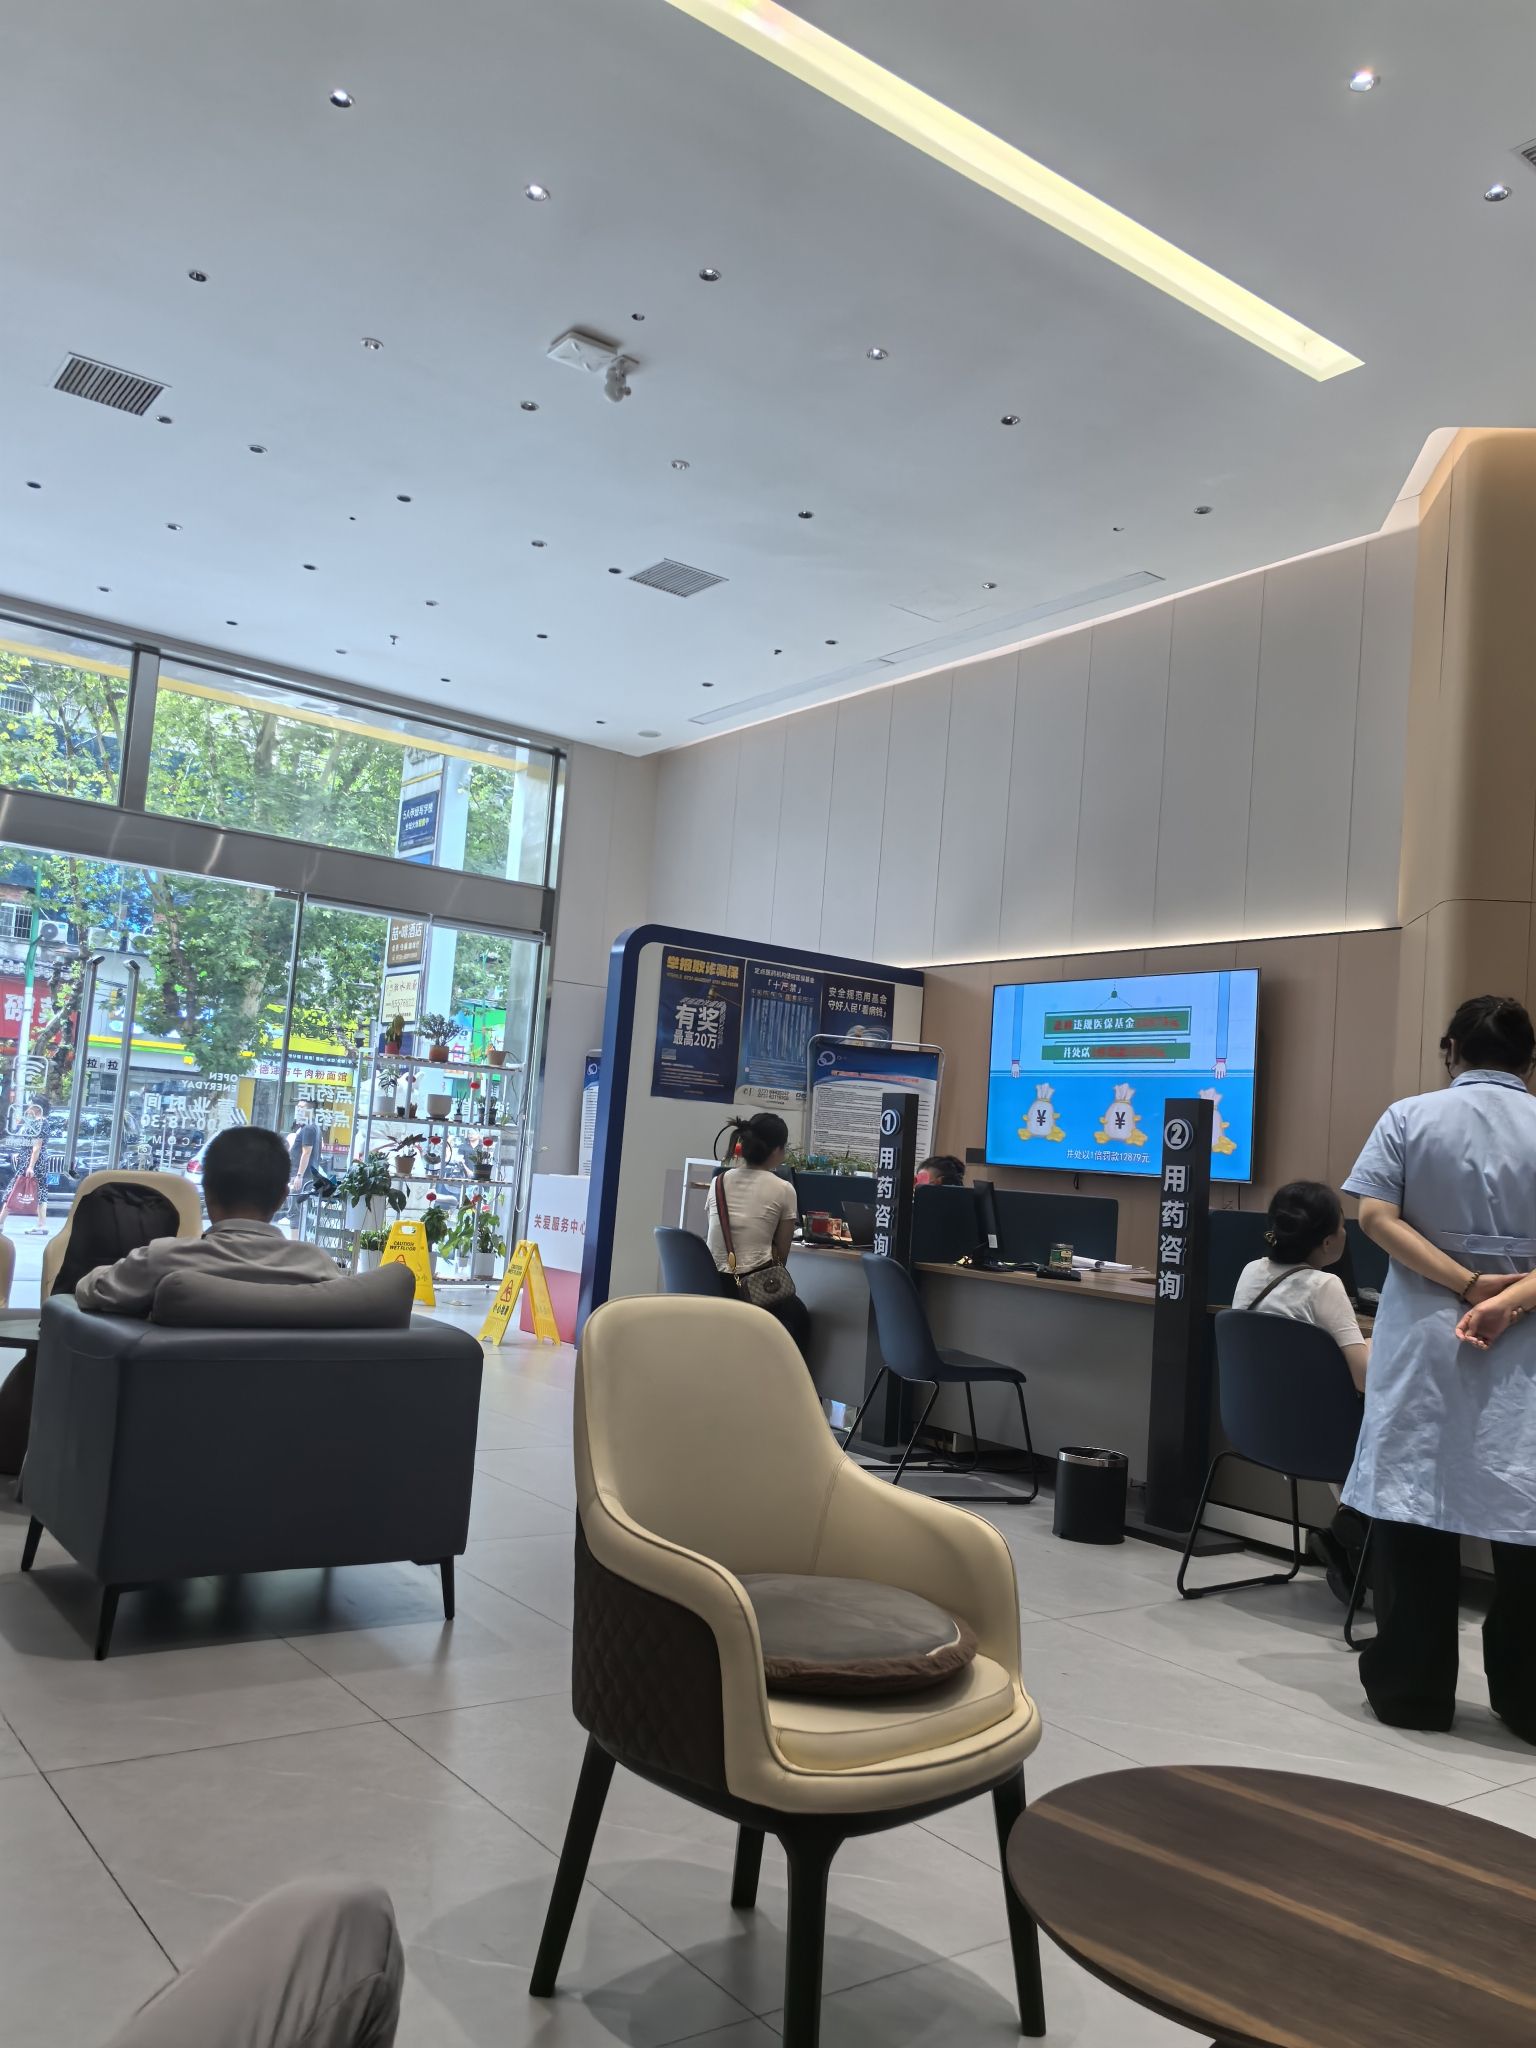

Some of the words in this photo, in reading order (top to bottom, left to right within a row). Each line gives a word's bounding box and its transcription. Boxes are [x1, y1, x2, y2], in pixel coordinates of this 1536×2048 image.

[675, 1003, 720, 1033] 有奖
[672, 1028, 717, 1049] 最高20万
[86, 1058, 98, 1069] 拉
[107, 1060, 119, 1071] 拉
[873, 1147, 895, 1257] 用药咨询
[1158, 1165, 1186, 1300] 用药咨询
